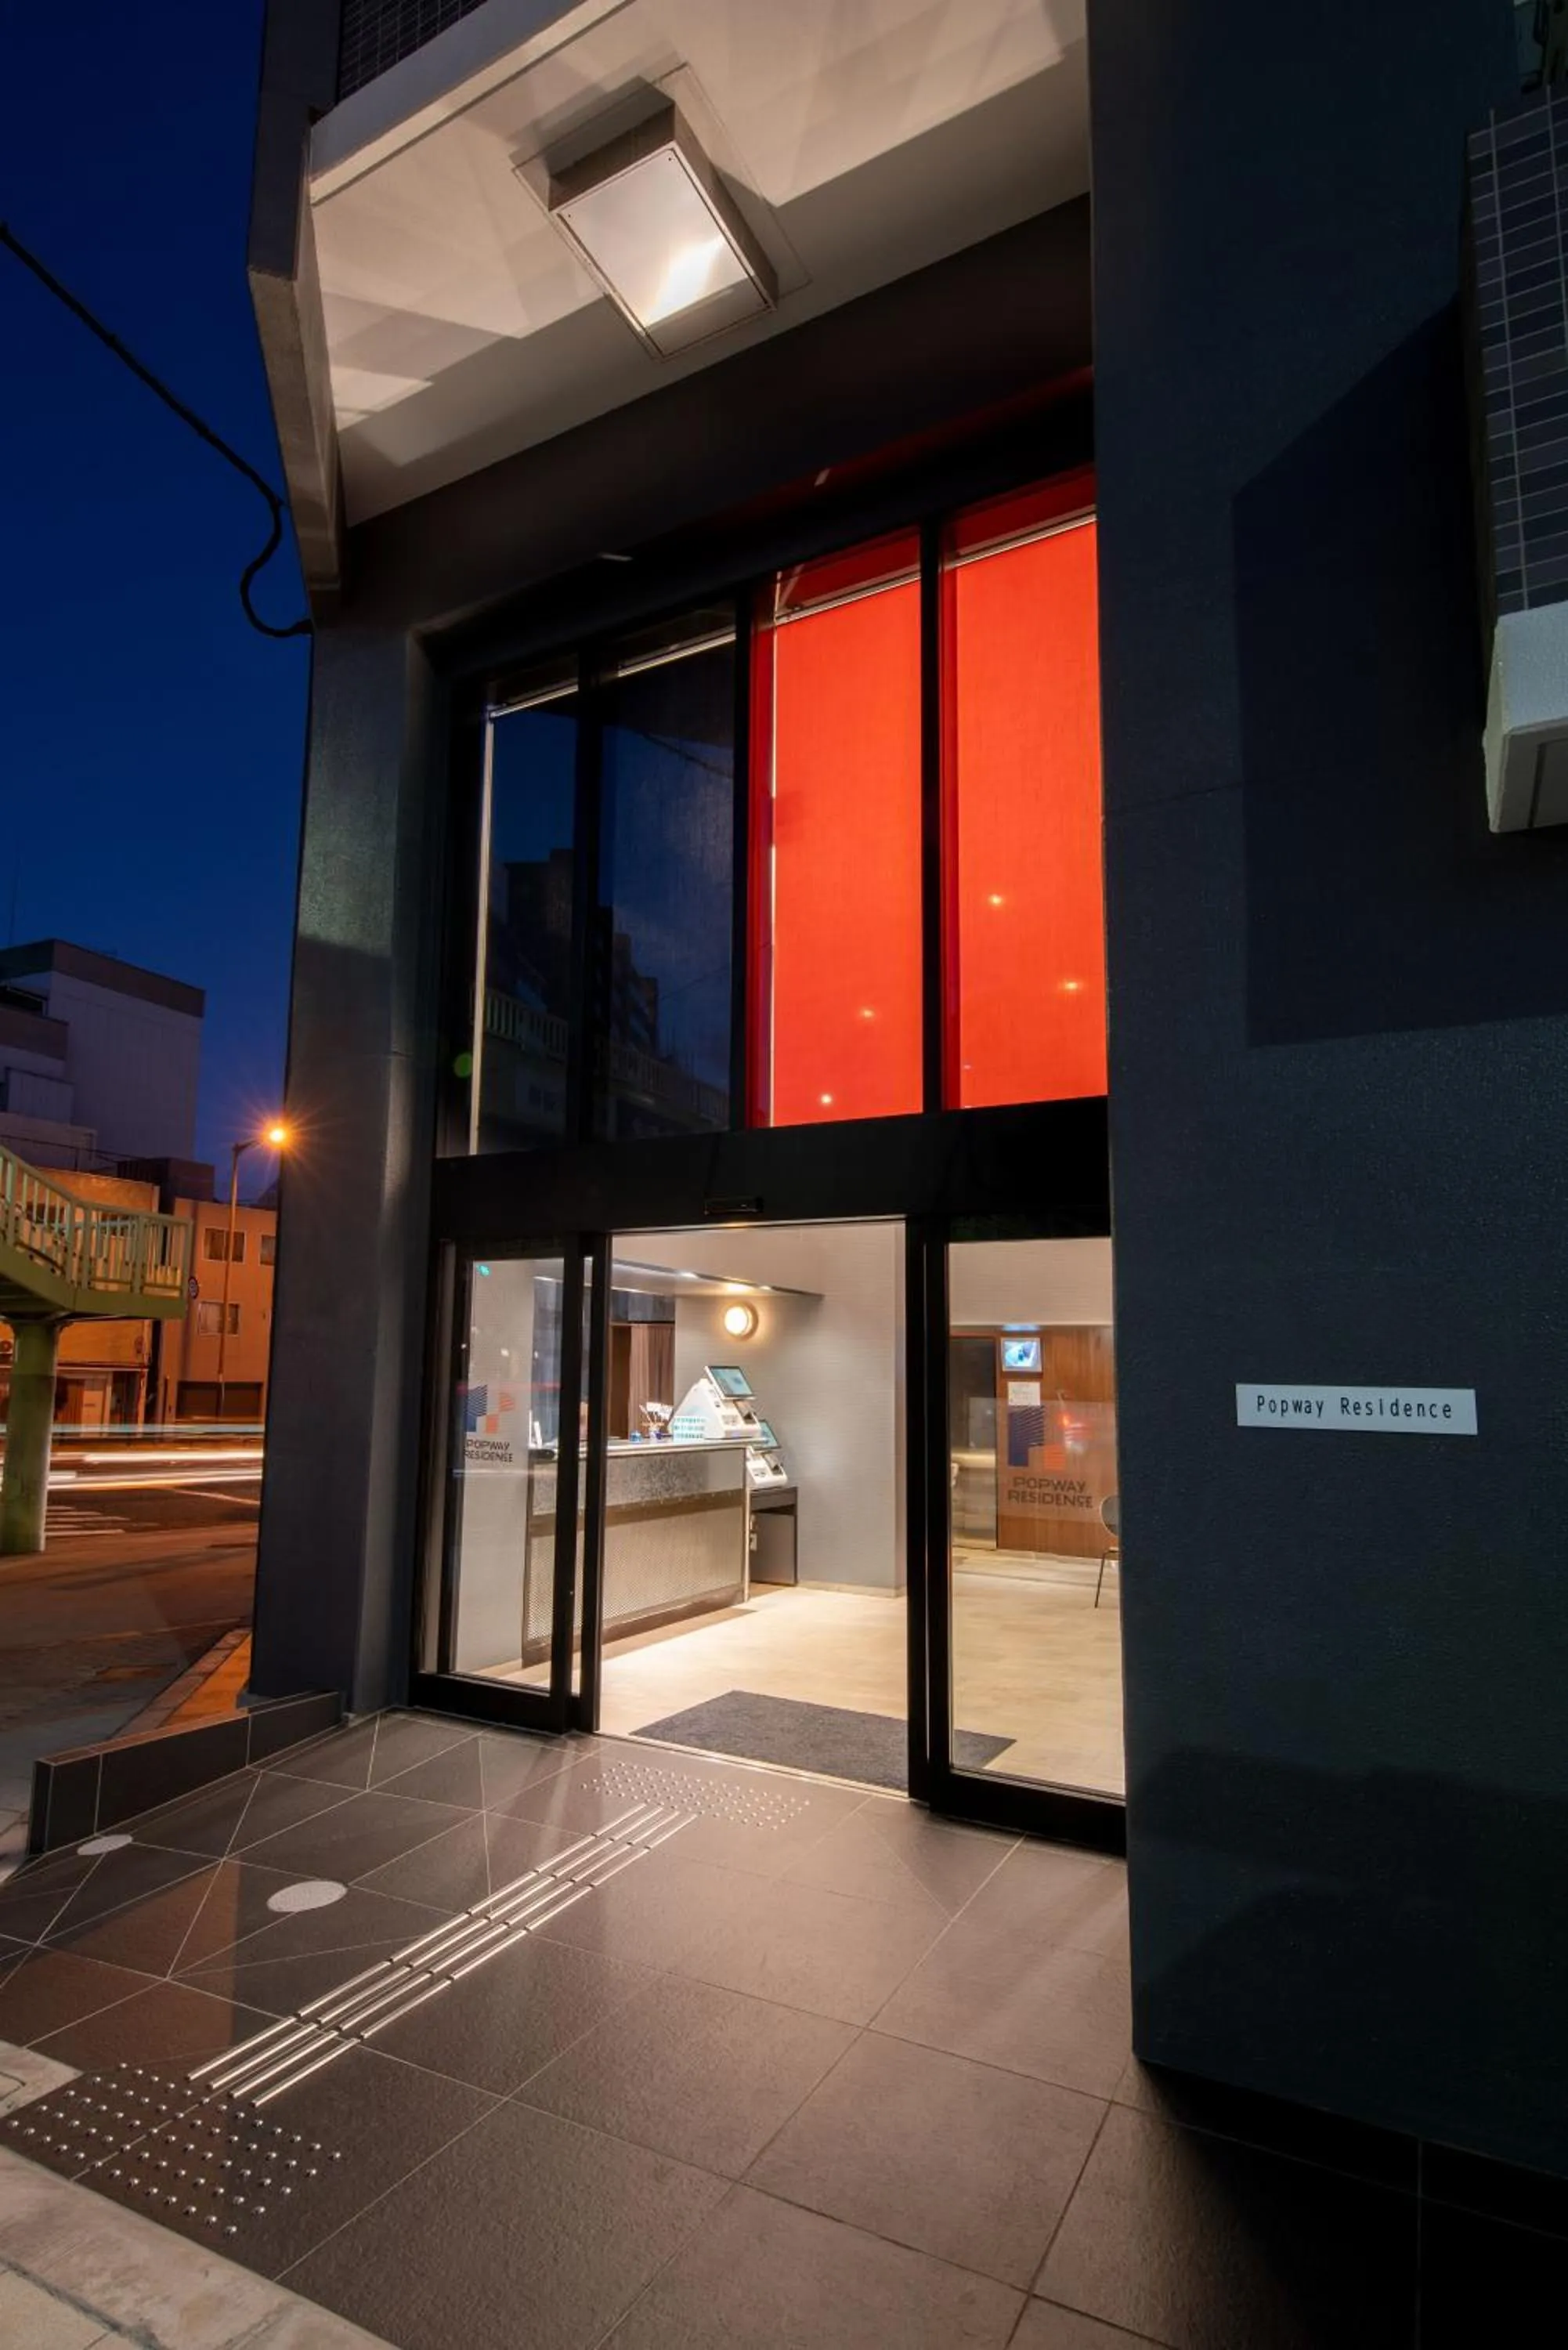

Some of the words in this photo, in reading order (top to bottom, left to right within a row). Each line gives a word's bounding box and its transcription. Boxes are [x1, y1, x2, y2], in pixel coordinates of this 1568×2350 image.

[1257, 1395, 1324, 1418] Popway
[1340, 1397, 1451, 1419] Residence
[467, 1439, 510, 1451] POPWAY
[1013, 1477, 1086, 1493] POPWAY
[1008, 1490, 1093, 1509] RESIDENCE
